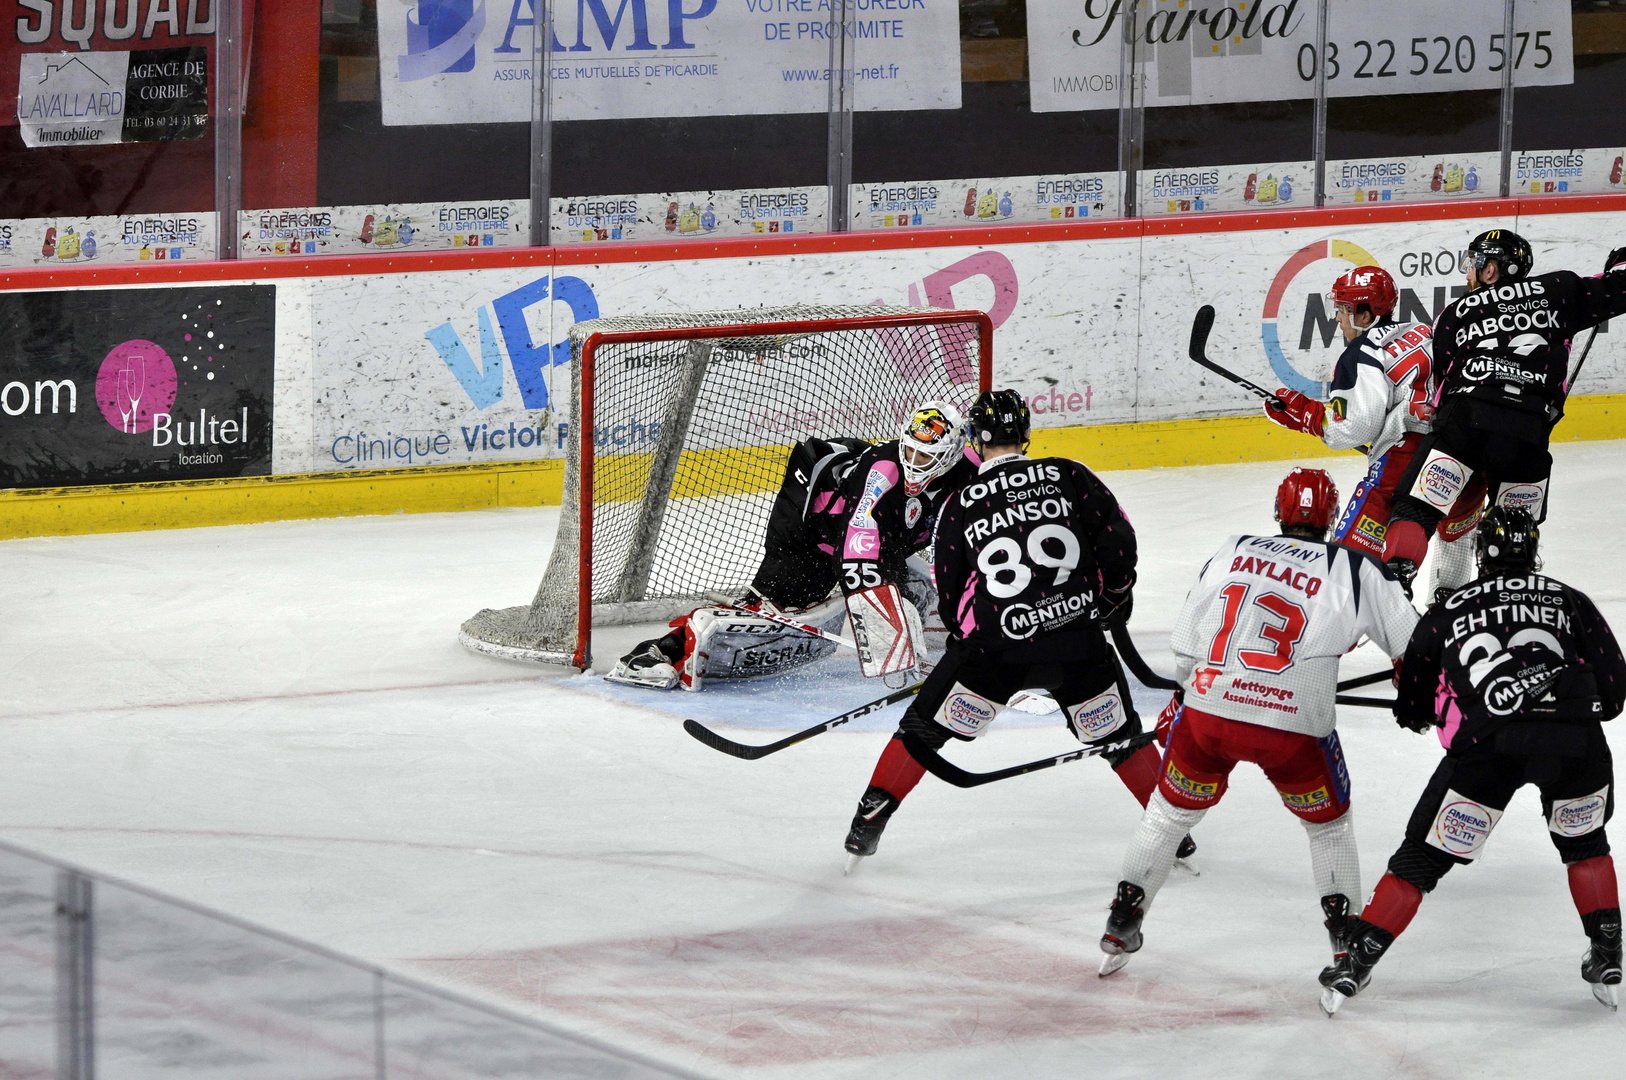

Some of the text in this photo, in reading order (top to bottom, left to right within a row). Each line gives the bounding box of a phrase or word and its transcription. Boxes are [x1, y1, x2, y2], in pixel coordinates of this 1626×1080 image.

[747, 0, 812, 13] VOTRE
[16, 0, 215, 50] SQUAD
[493, 0, 716, 54] AMP
[765, 20, 904, 40] DE PROXIMITE
[1297, 30, 1553, 81] 03 22 520 575
[130, 61, 205, 79] AGENCE DE
[493, 63, 718, 81] ASSURANCES MUTUELLES DE PICARDIE
[140, 84, 188, 100] CORBIE
[20, 91, 123, 119] LAVALLARD
[145, 116, 154, 127] 03
[157, 116, 166, 126] 60
[169, 116, 178, 126] 24
[37, 126, 103, 142] Immobilier
[1341, 174, 1406, 187] DU SANTERRE
[1517, 166, 1583, 178] DU SANTERRE
[1037, 190, 1103, 203] DU SANTERRE
[1153, 183, 1219, 197] DU SANTERRE
[568, 214, 583, 225] DU
[740, 205, 808, 217] DU SANTERRE
[438, 217, 509, 230] DU SANTERRE
[123, 233, 140, 245] DU
[1497, 297, 1550, 314] Service
[1455, 309, 1561, 348] BABCOCK
[1383, 324, 1434, 359] FABR
[1469, 359, 1548, 385] MENTION
[1494, 357, 1521, 369] GROUPE
[152, 405, 249, 447] Bultel
[1004, 412, 1013, 422] 89
[331, 431, 451, 464] Clinique
[461, 421, 543, 453] Victor
[178, 452, 224, 466] location
[1427, 470, 1446, 484] FOR
[1429, 463, 1462, 485] AMIENS
[1425, 476, 1453, 496] YOUTH
[1504, 491, 1539, 499] AMIENS
[1301, 497, 1312, 506] 13
[963, 496, 1074, 550] FRANSON
[1513, 532, 1523, 542] 29
[977, 523, 1081, 599] 89
[842, 562, 882, 590] 35
[1230, 555, 1322, 600] BAYLACQ
[1035, 592, 1065, 609] GROUPE
[1445, 575, 1563, 610] Coriolis
[1498, 591, 1564, 606] Service
[1011, 589, 1094, 632] MENTION
[725, 623, 787, 635] CCM
[1207, 581, 1309, 676] 13
[852, 612, 873, 665] CCM
[1516, 662, 1547, 679] GROUPE
[1232, 677, 1295, 700] Nettoyage
[952, 701, 971, 716] FOR
[954, 696, 992, 717] AMIENS
[1079, 699, 1115, 719] AMIENS
[1222, 690, 1300, 716] Assainissement
[825, 699, 889, 732] CCM
[949, 707, 981, 727] YOUTH
[1080, 712, 1102, 726] FOR
[1081, 713, 1115, 730] YOUTH
[1054, 738, 1132, 767] CCM
[1444, 815, 1466, 831] FOR
[1447, 808, 1488, 829] AMIENS
[1443, 822, 1477, 842] YOUTH
